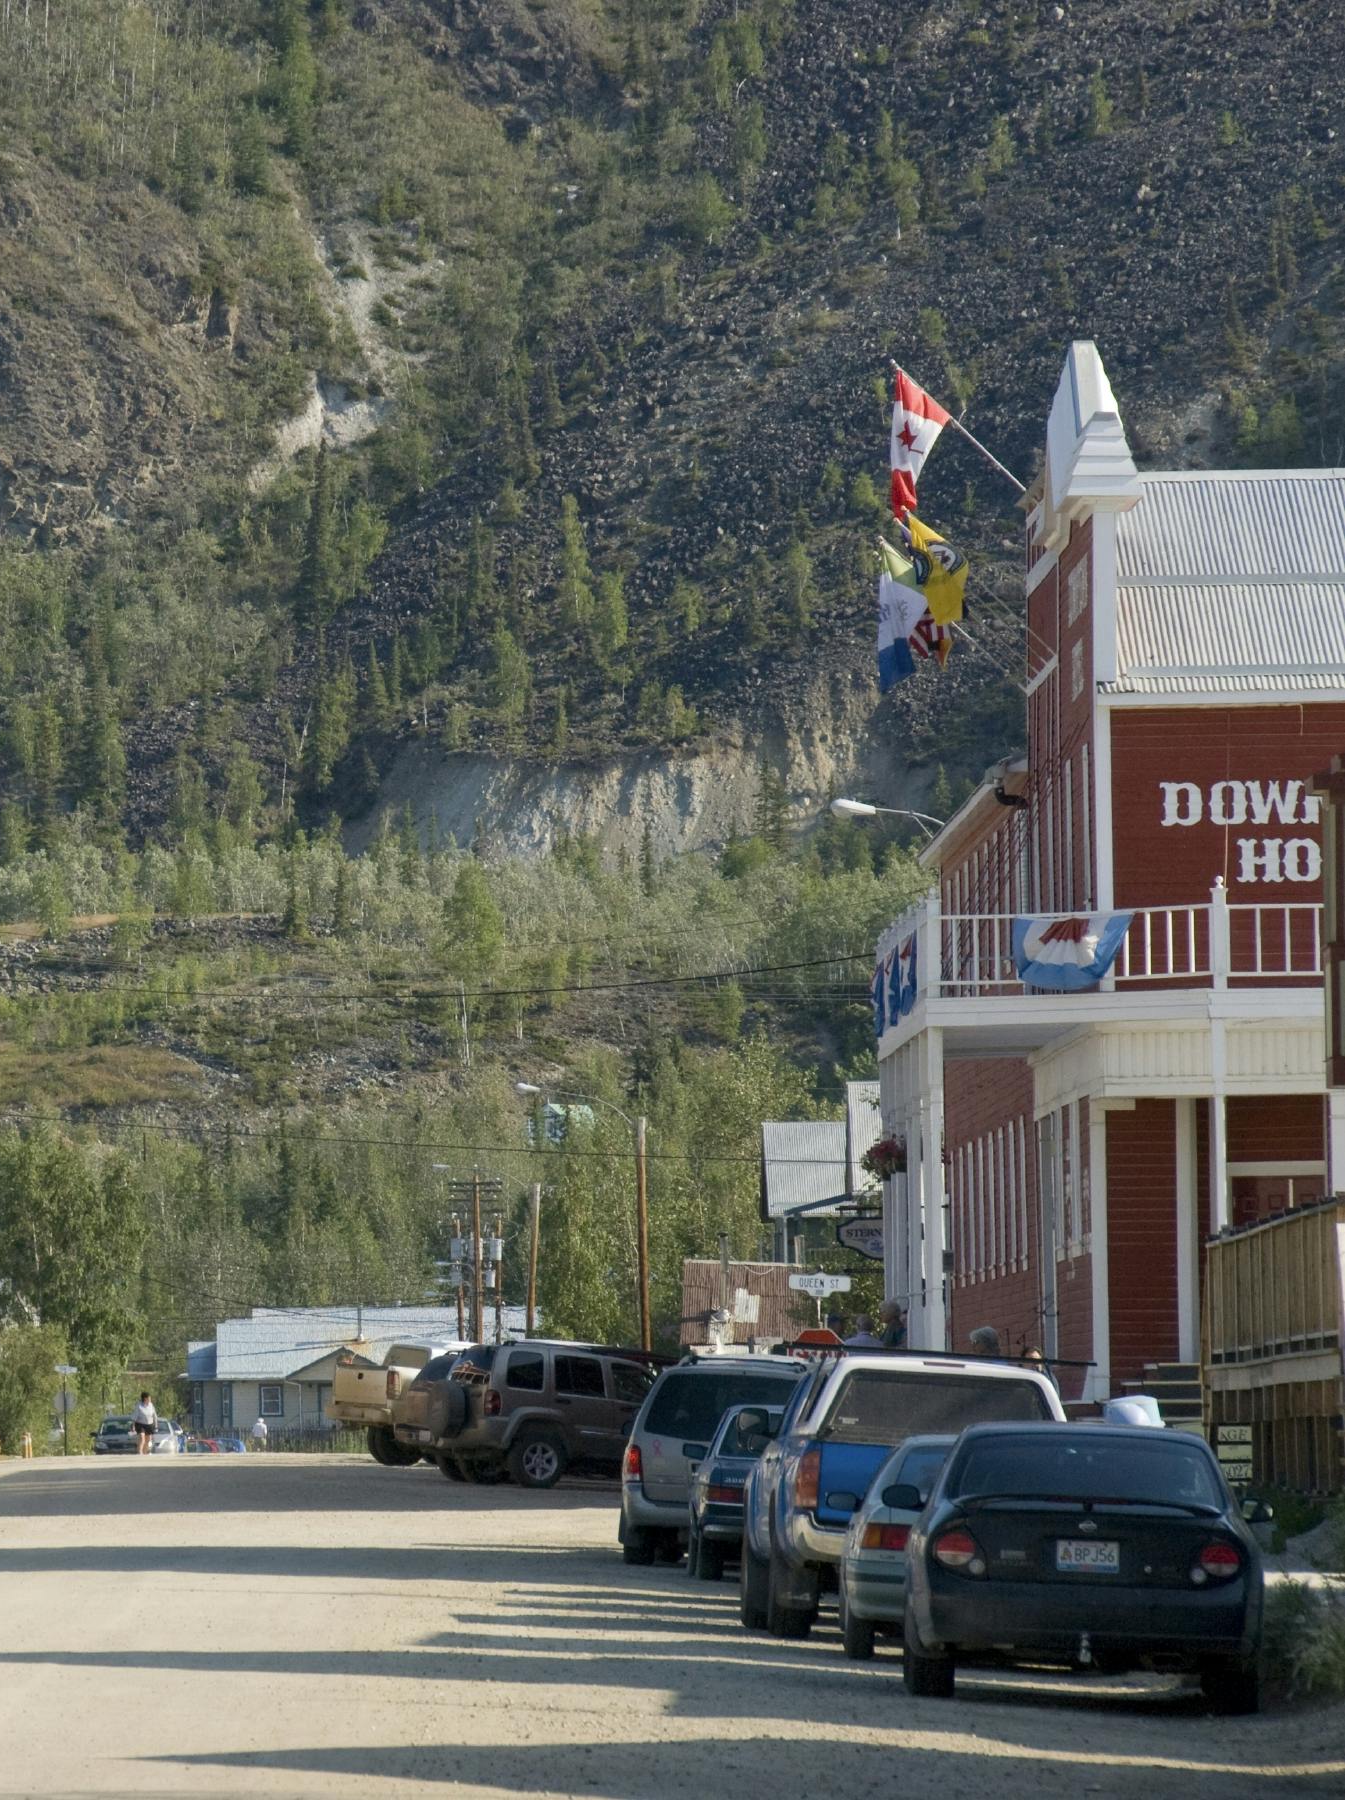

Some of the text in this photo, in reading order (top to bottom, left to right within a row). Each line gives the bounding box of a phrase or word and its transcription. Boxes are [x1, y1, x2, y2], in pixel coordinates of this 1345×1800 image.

[1236, 838, 1323, 883] HO
[799, 1277, 839, 1289] QUEEN ST
[1074, 1549, 1115, 1563] BPJ56
